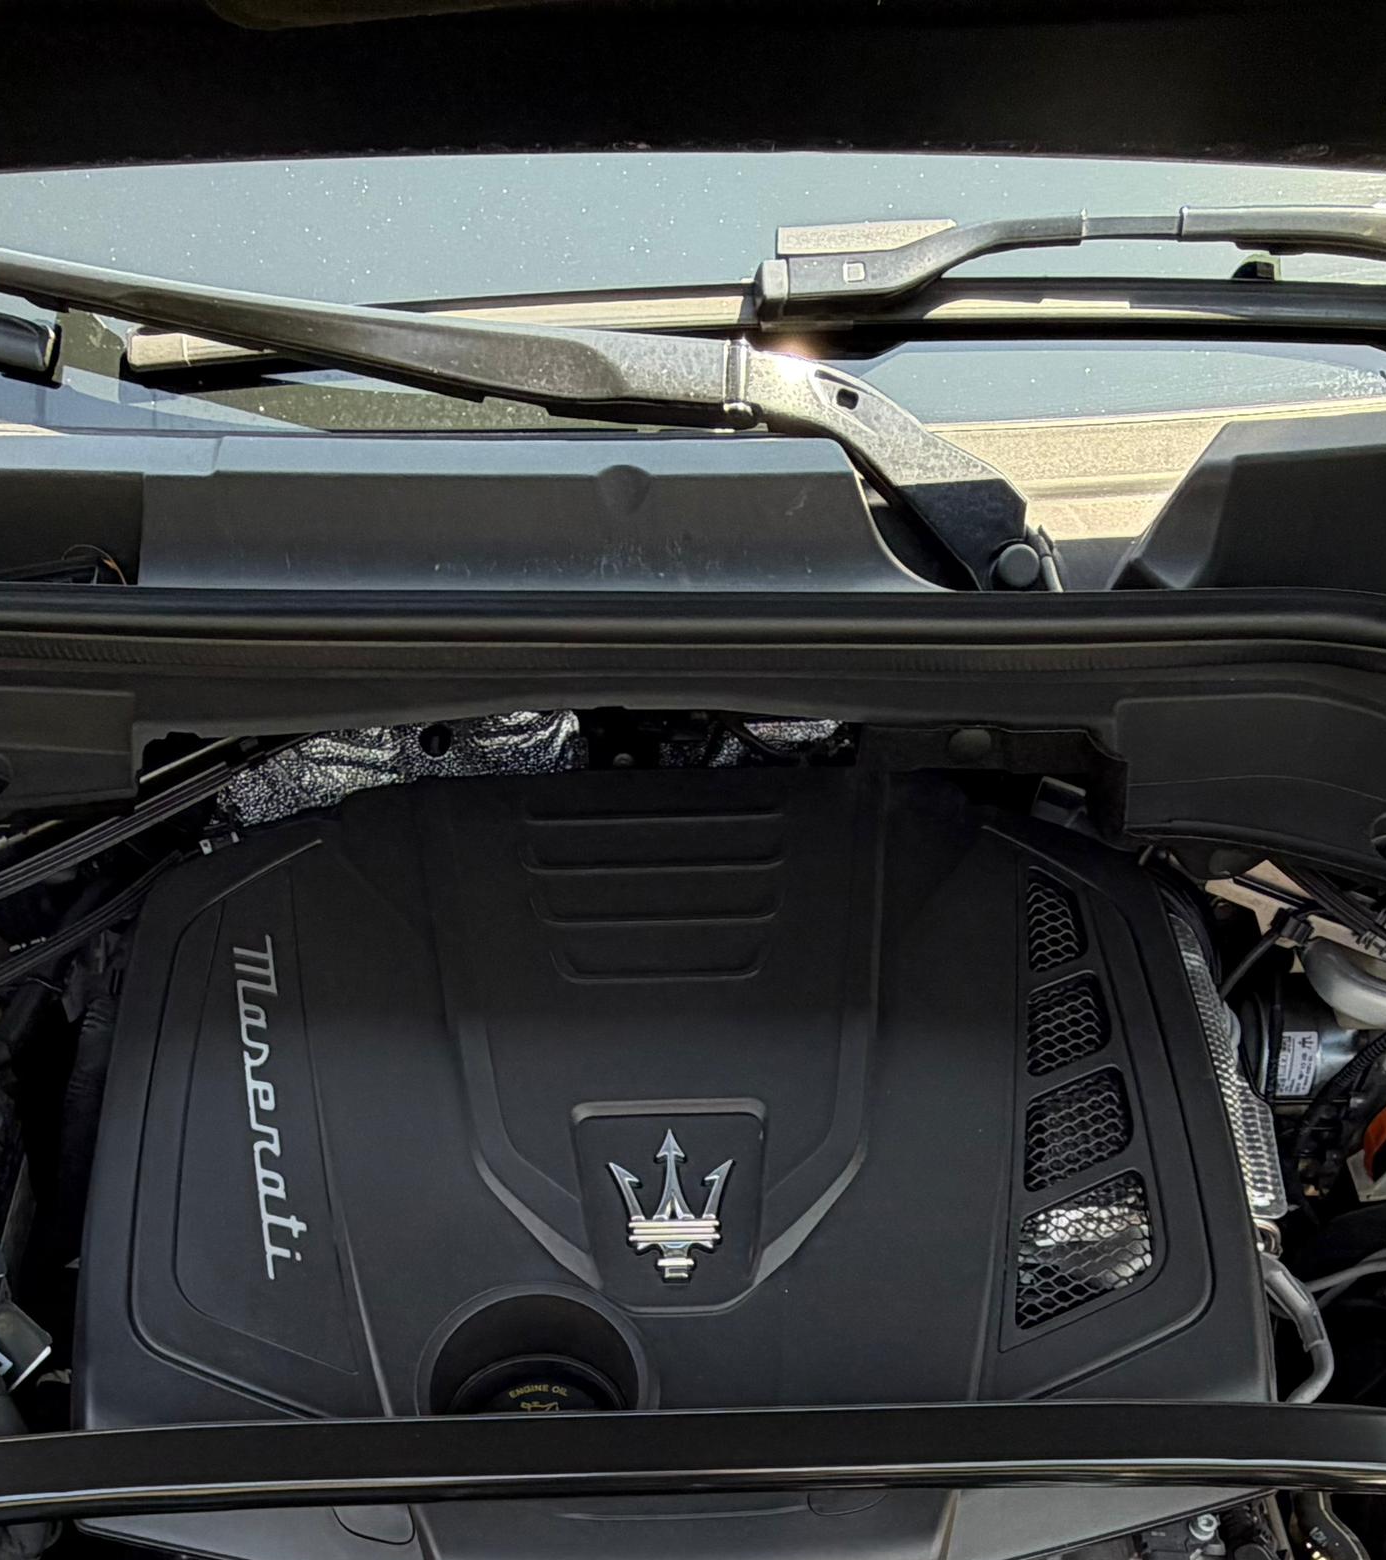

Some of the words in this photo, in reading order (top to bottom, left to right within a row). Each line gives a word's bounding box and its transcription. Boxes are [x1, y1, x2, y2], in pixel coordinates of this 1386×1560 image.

[233, 934, 308, 1280] Maserati
[508, 1384, 550, 1399] ENGINE
[551, 1385, 569, 1397] OIL
